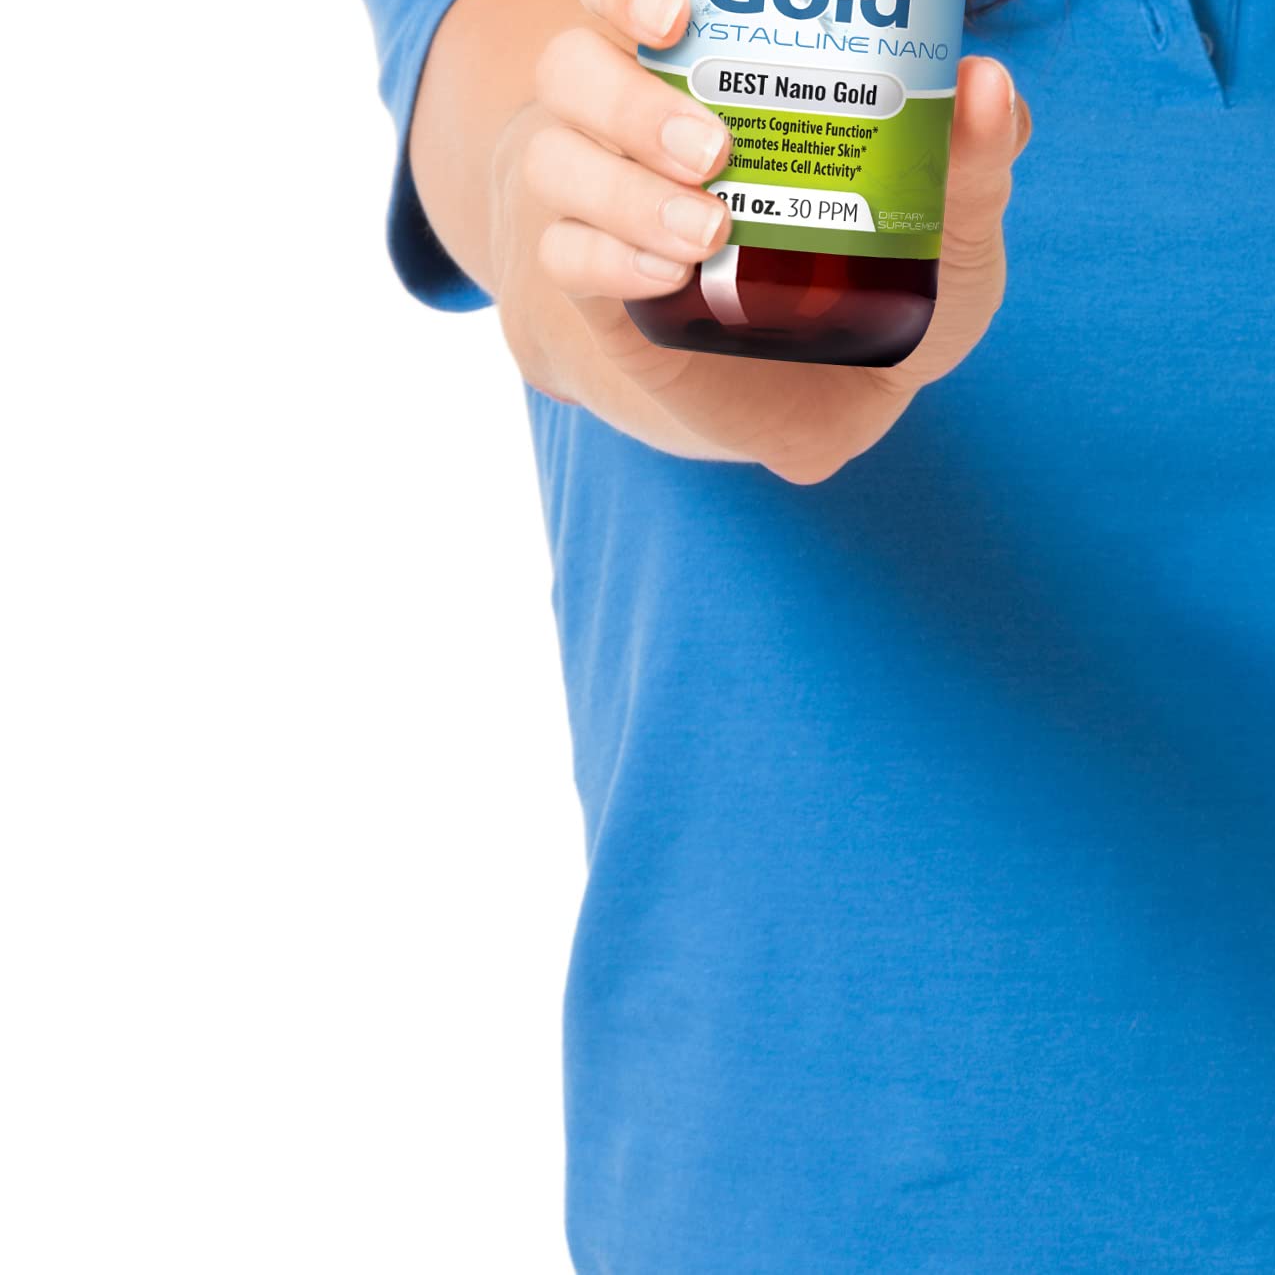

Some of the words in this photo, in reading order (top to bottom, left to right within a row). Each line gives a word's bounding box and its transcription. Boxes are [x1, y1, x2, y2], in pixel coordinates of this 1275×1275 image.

[877, 38, 949, 61] NANO
[718, 70, 769, 96] BEST
[775, 76, 827, 101] Nano
[833, 81, 878, 106] Gold
[769, 116, 823, 135] Cognitive
[781, 138, 836, 157] Healthier
[727, 153, 788, 173] Stimulates
[790, 159, 811, 175] Cell
[732, 192, 746, 213] fl
[751, 198, 781, 217] oz.
[787, 198, 812, 220] 30
[818, 200, 858, 223] PPM
[878, 211, 925, 221] DIETARY
